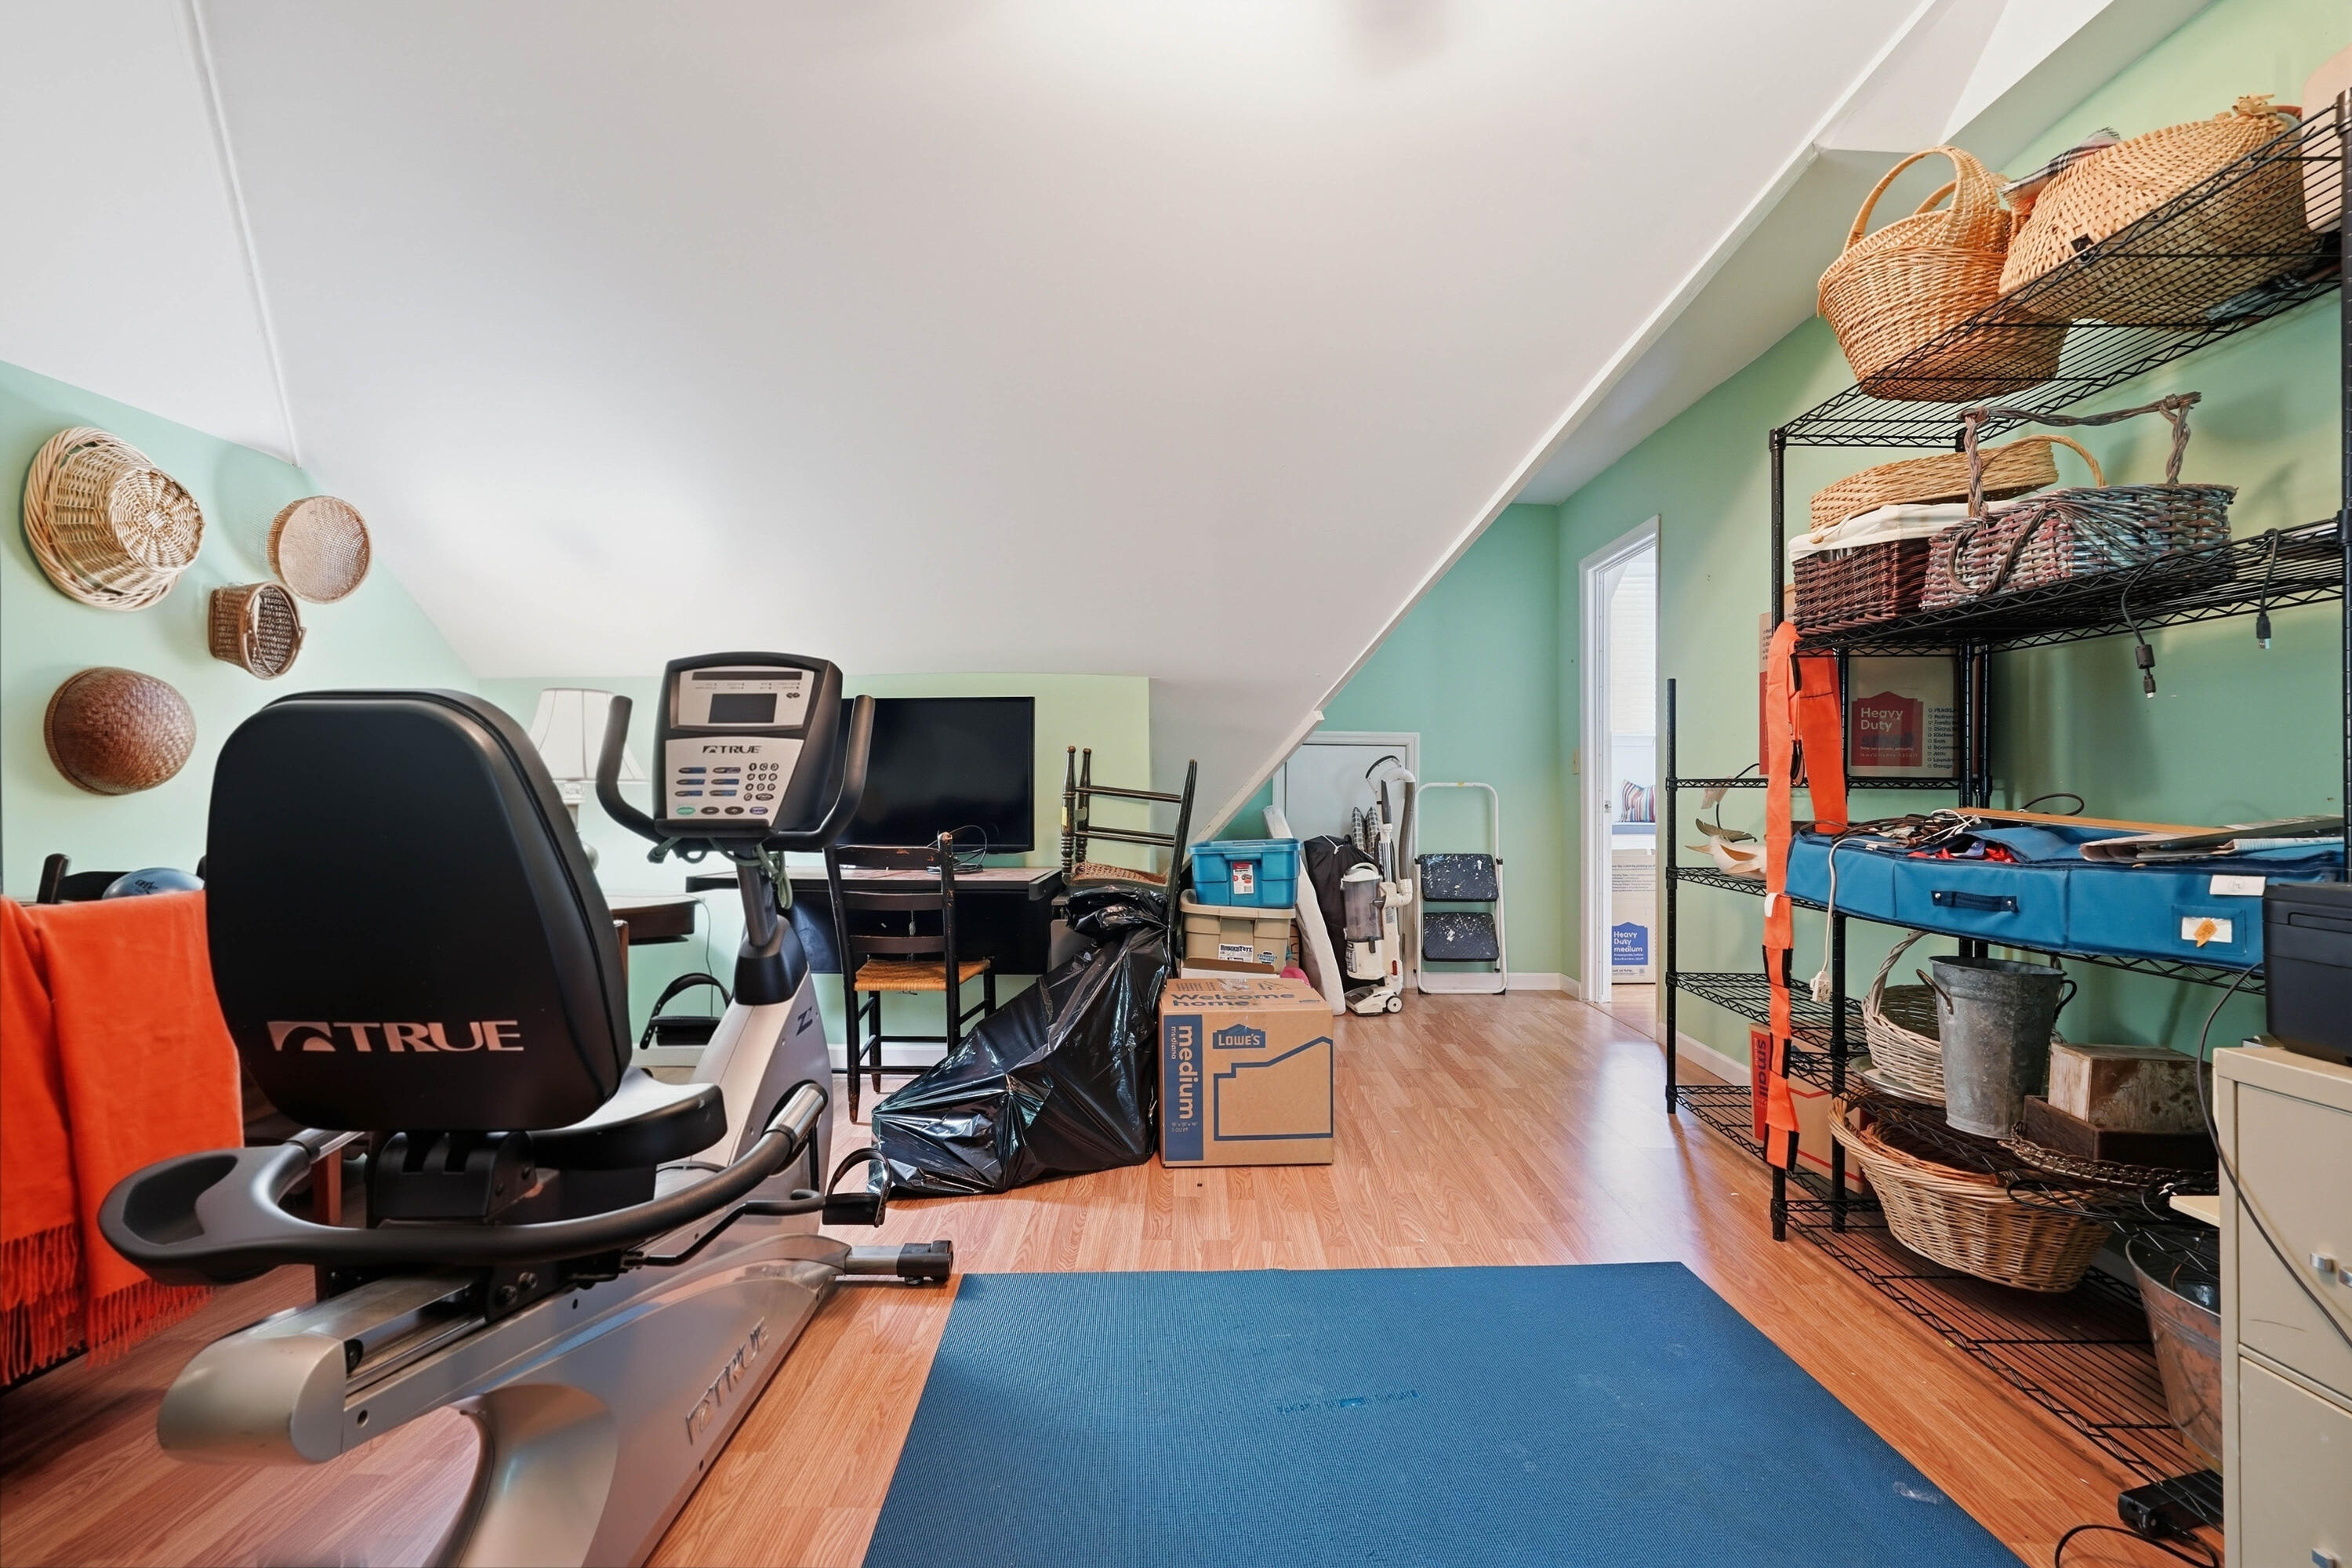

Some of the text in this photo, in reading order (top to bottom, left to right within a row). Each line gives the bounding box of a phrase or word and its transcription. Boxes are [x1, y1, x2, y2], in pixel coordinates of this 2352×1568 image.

[1860, 707, 1904, 720] Heavy
[1860, 720, 1893, 732] Duty
[720, 746, 761, 754] TRUE
[333, 1020, 524, 1052] TRUE
[1218, 1034, 1261, 1046] LOWE'S
[1179, 1025, 1198, 1120] medium
[1758, 1040, 1769, 1096] small
